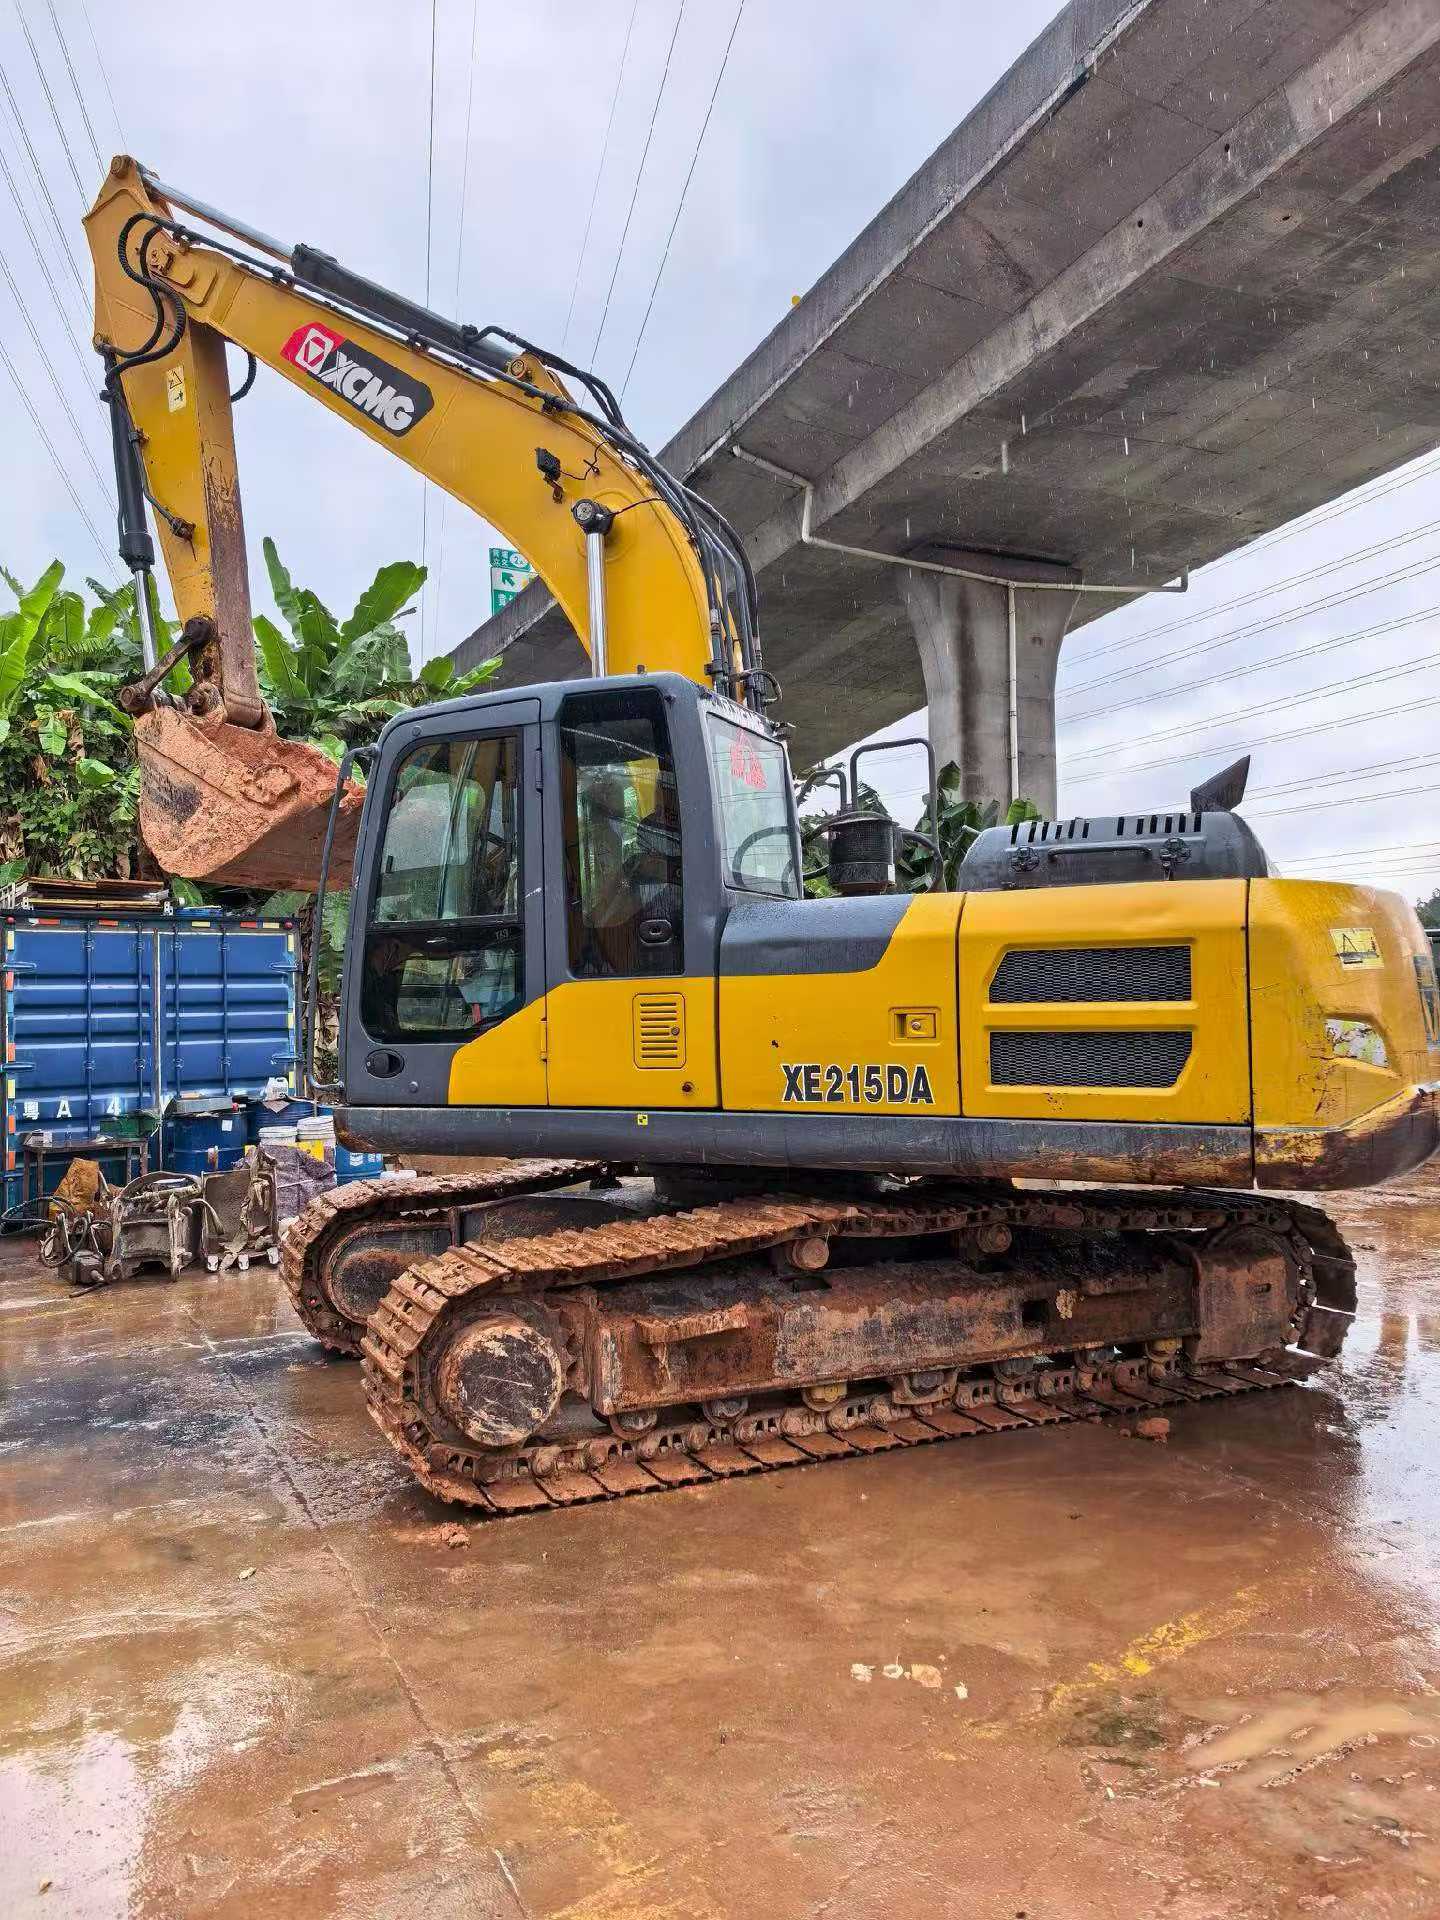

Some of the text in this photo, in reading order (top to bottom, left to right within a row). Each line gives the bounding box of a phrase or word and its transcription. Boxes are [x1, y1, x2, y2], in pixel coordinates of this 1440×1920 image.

[318, 350, 415, 431] XCMG
[780, 1063, 936, 1105] XE215DA
[56, 1096, 72, 1119] A
